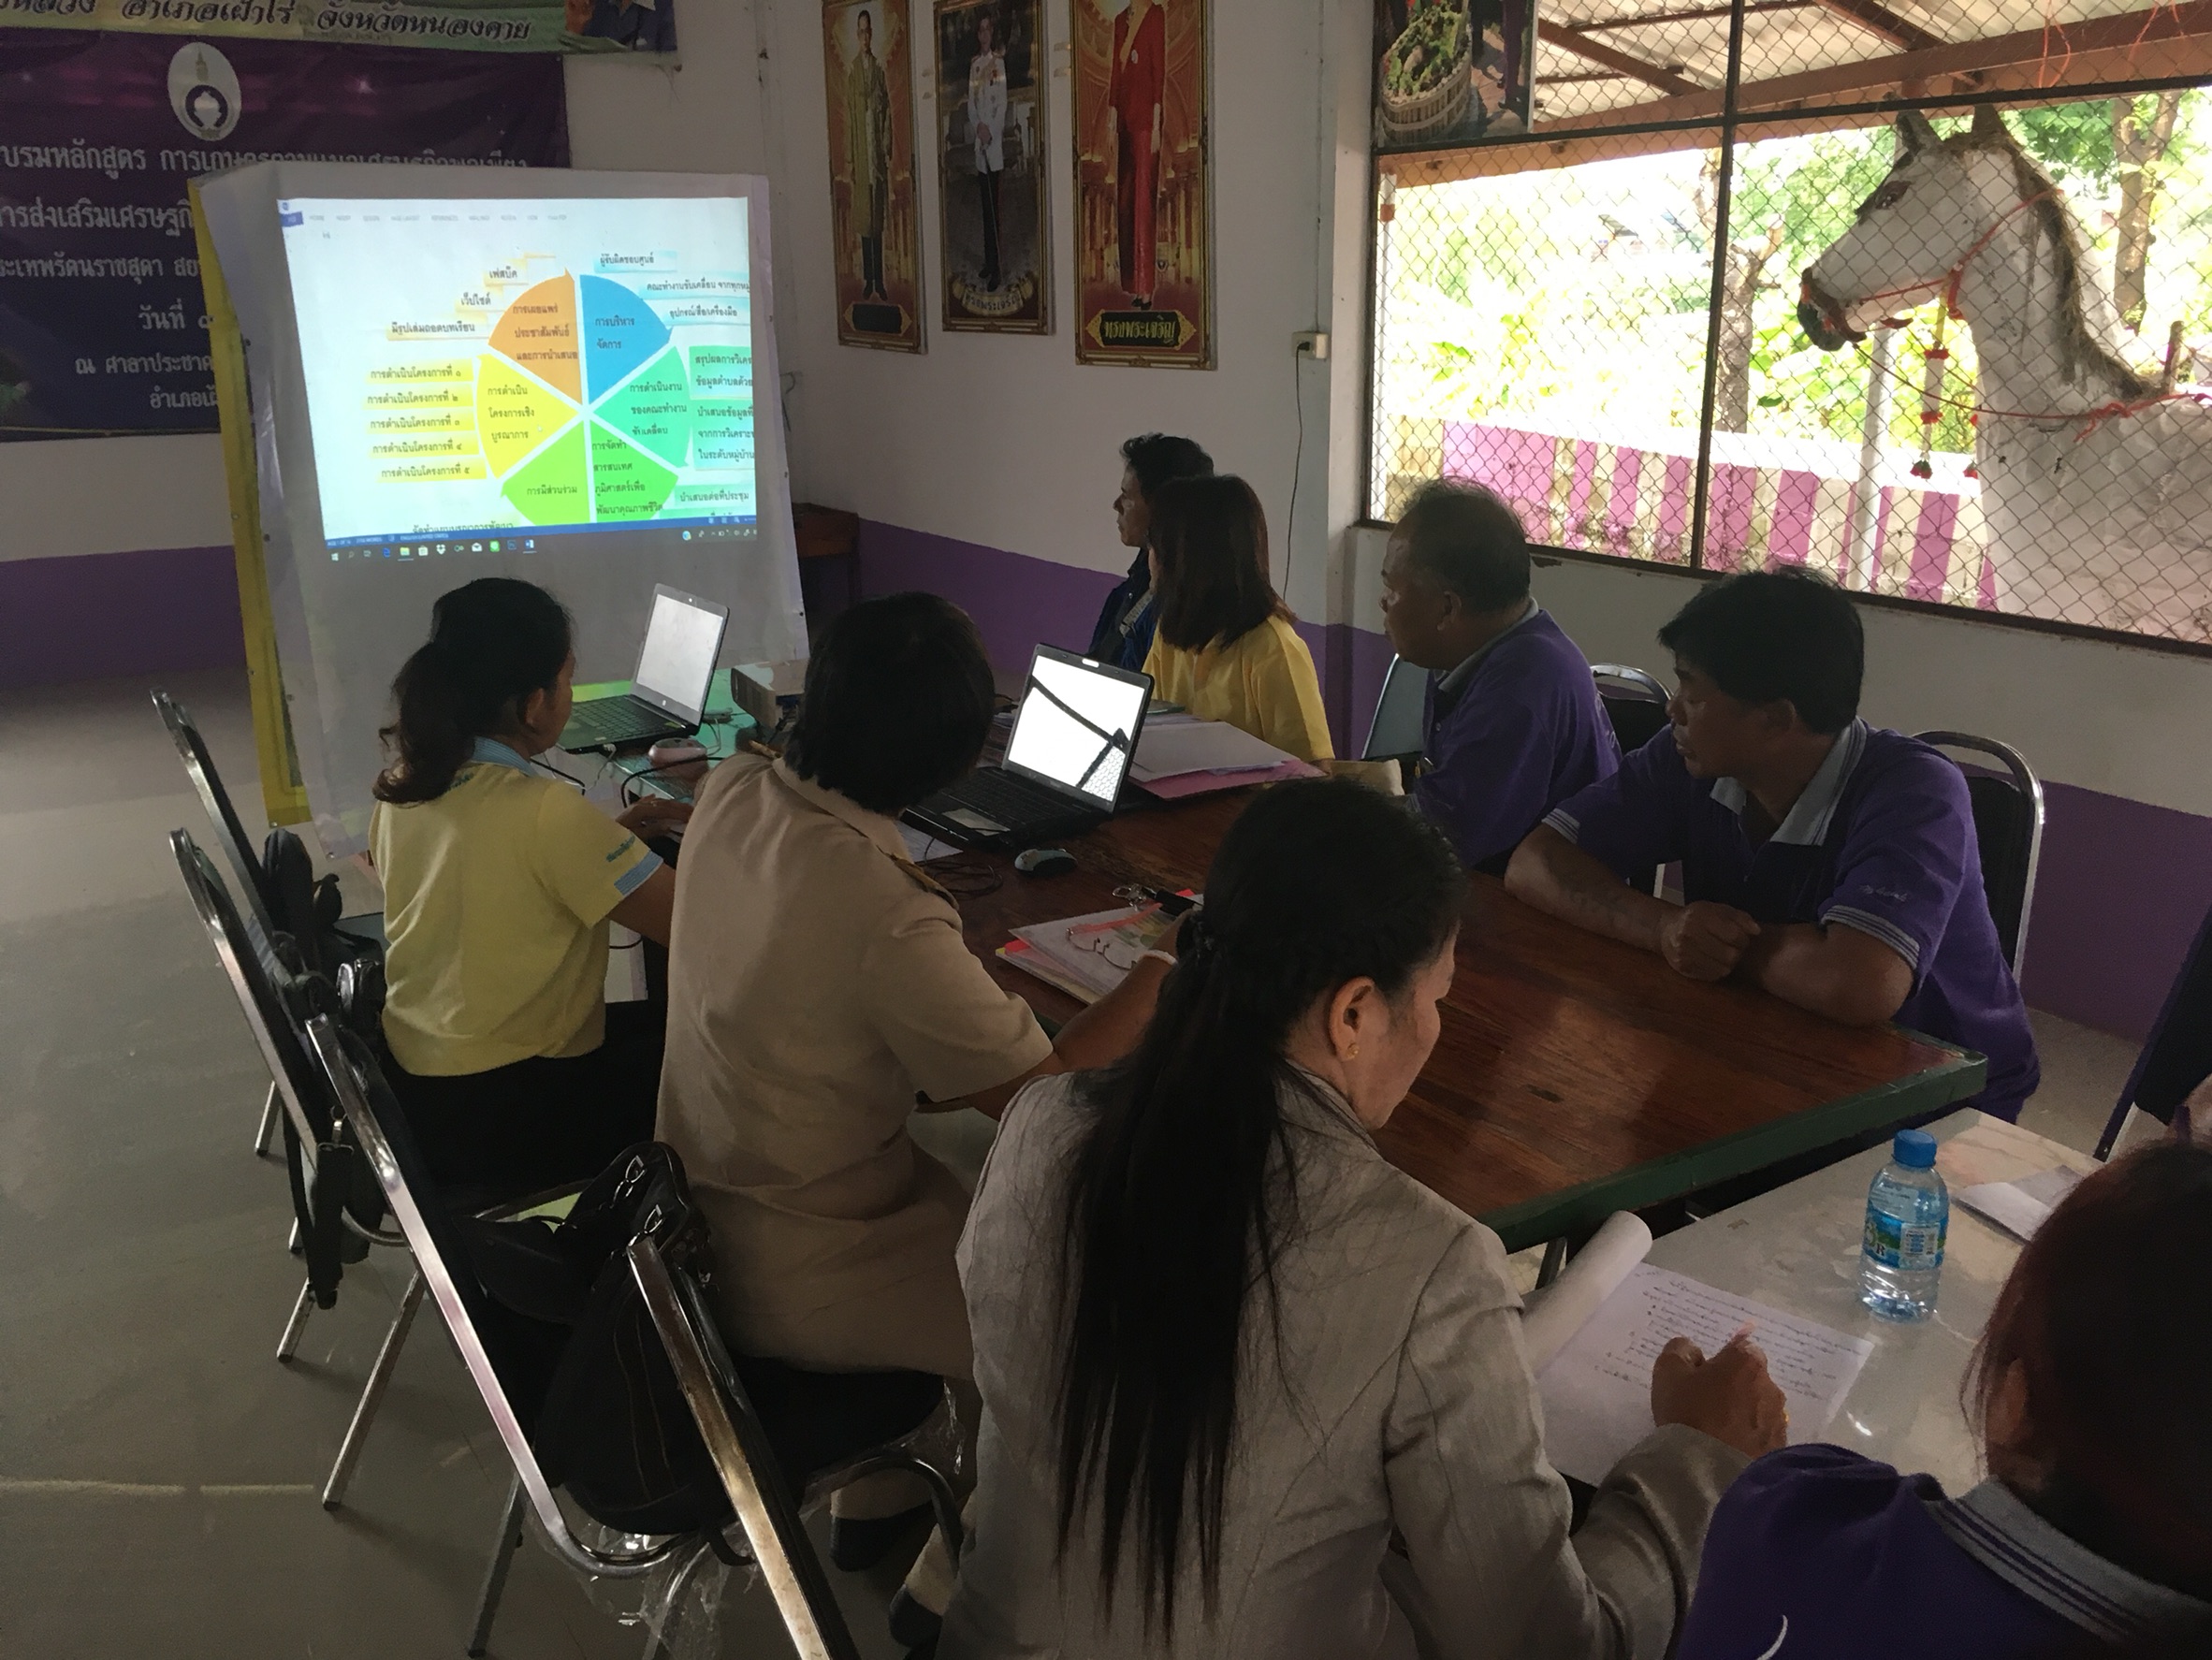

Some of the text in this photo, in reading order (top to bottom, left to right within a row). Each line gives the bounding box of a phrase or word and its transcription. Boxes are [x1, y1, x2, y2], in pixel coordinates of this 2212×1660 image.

[123, 0, 295, 24] อำเภอเฝาไร่
[317, 0, 531, 39] จังหวัดหนองคาย
[0, 197, 194, 237] ารส่งเสริมเศรษฐกิ
[138, 299, 185, 330] วันที่
[595, 314, 634, 327] การบริหาร
[1104, 314, 1176, 344] ทรงพระเจริญ
[597, 338, 621, 349] จัดการ
[75, 357, 95, 374] ณ
[488, 385, 528, 396] การดำเนิน
[630, 381, 682, 392] การดำเนินงาน
[488, 406, 535, 418] โครงการเชิง
[631, 402, 687, 415] ของคณะทำงาน
[491, 430, 529, 444] บูรณาการ
[592, 439, 627, 450] การจัดทำ
[527, 484, 578, 496] การมีส่วนร่วม
